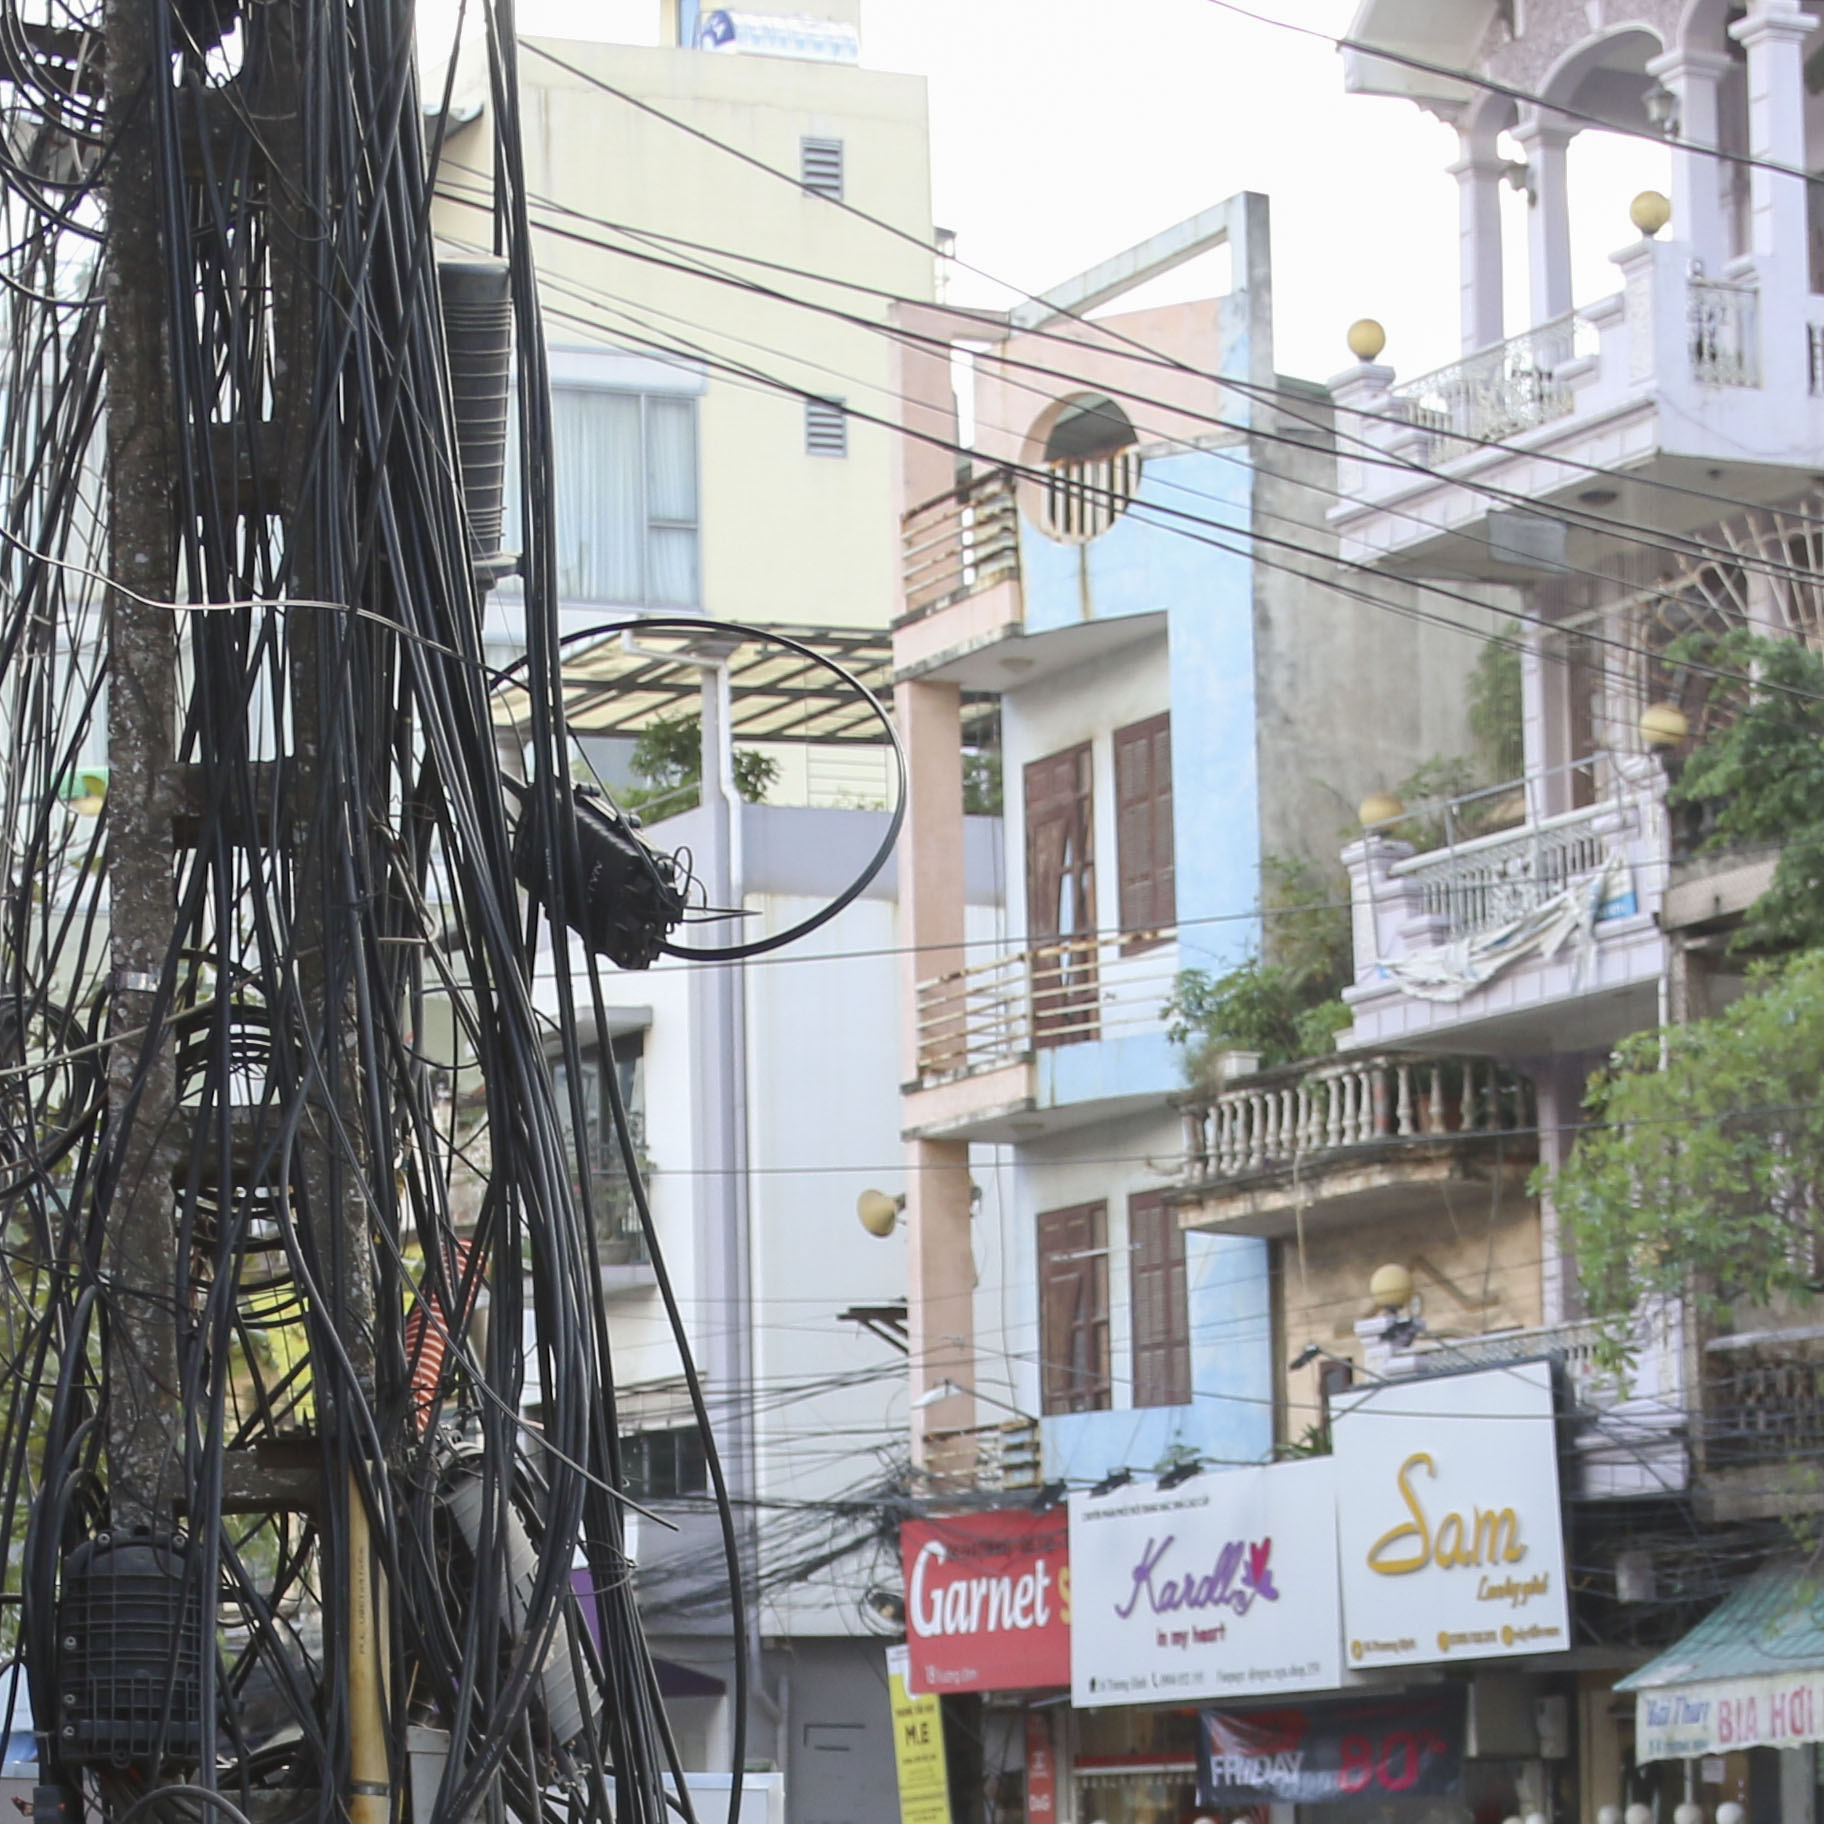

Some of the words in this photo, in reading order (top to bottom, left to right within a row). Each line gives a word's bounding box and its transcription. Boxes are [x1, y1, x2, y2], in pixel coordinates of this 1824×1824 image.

[1367, 1453, 1528, 1575] Sam
[910, 1541, 1051, 1637] Garnet
[1157, 1630, 1168, 1647] in
[1172, 1630, 1189, 1650] my
[1193, 1623, 1226, 1643] heart
[1719, 1696, 1759, 1744] BIA
[1770, 1685, 1814, 1737] HƠI
[1210, 1752, 1303, 1786] FRIDAY
